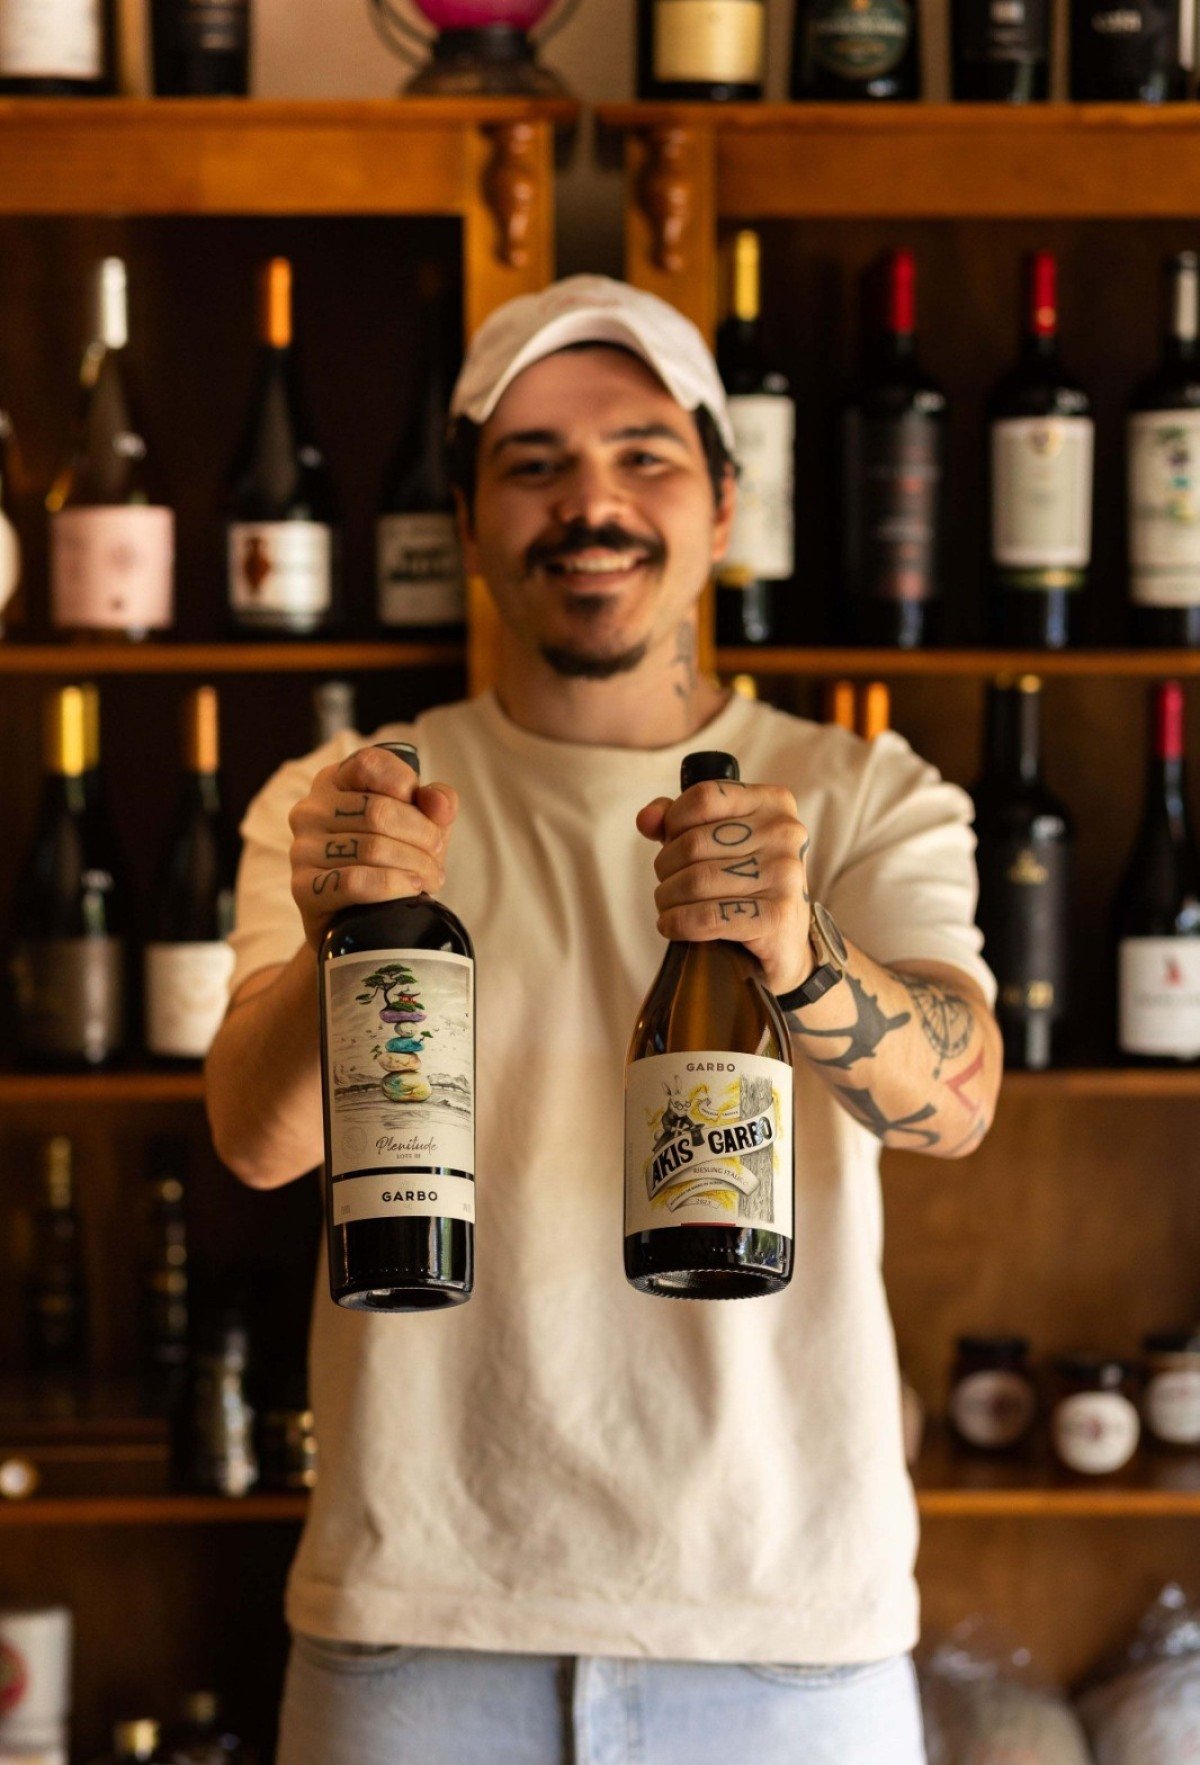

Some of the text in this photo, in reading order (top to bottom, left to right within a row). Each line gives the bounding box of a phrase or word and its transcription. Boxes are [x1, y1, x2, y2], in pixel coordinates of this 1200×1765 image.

[686, 1062, 736, 1073] GARBO
[375, 1135, 439, 1156] Plenitude
[651, 1116, 774, 1191] AKIS GARBO
[382, 1190, 439, 1202] GARBO
